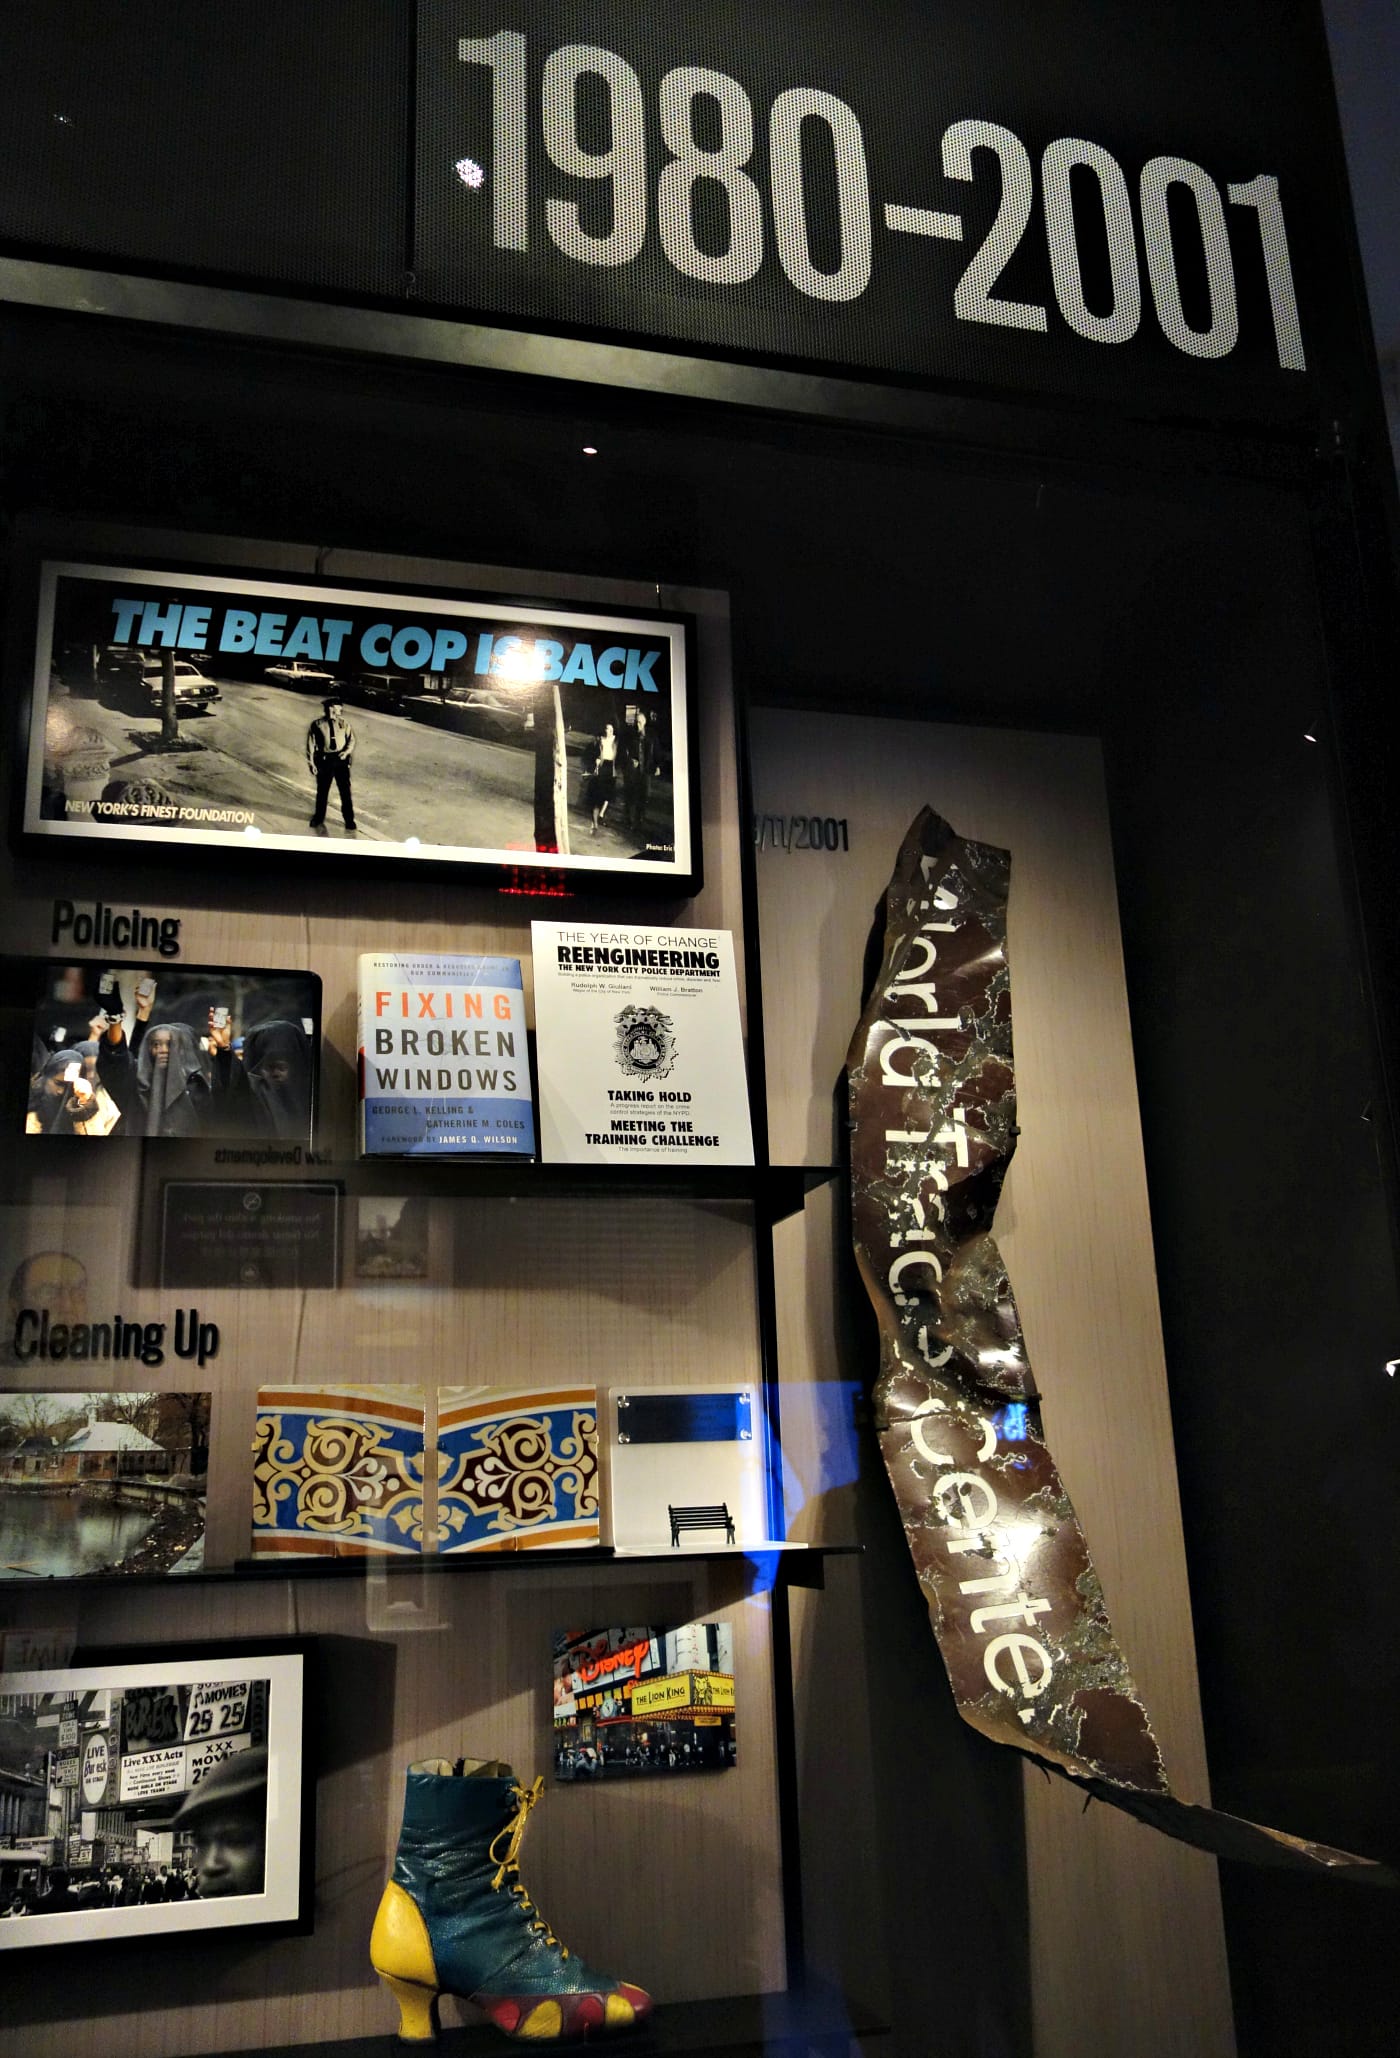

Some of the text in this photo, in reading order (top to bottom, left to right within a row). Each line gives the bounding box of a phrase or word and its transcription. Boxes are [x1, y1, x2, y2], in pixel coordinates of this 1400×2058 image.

[112, 599, 212, 650] THE
[219, 609, 352, 661] BEAT
[360, 623, 467, 671] COP
[534, 639, 661, 692] BACK
[64, 800, 254, 824] NEW YORK'S FINEST FOUNDATION
[754, 816, 849, 854] /11/2001
[52, 900, 181, 957] Policing
[557, 931, 718, 949] THE YEAR OF CHANGE
[557, 945, 720, 969] REENGINEERING
[558, 964, 720, 977] THE NEW YORK CITY POLICE DEPARTMENT
[375, 991, 512, 1020] FIXING
[375, 1029, 515, 1057] BROKEN
[376, 1068, 517, 1092] WINDOWS
[607, 1090, 692, 1103] TAKING HOLD
[372, 1106, 412, 1115] GEORGE
[425, 1106, 464, 1115] KELLING
[467, 1106, 474, 1115] &
[426, 1119, 478, 1129] CATHERINE
[496, 1119, 525, 1130] COLES
[610, 1120, 693, 1132] MEETING THE
[439, 1135, 467, 1144] JAMES
[484, 1135, 518, 1144] WILSON
[585, 1133, 720, 1147] TRAINING CHALLENGE
[15, 1309, 219, 1366] Cleaning Up
[910, 1399, 1053, 1723] Cente
[204, 1682, 247, 1704] MOVIES
[636, 1687, 686, 1704] THE LION KING
[87, 1745, 105, 1760] LIVE
[123, 1757, 141, 1768] Live
[142, 1754, 162, 1765] XXX
[164, 1751, 183, 1761] Acts
